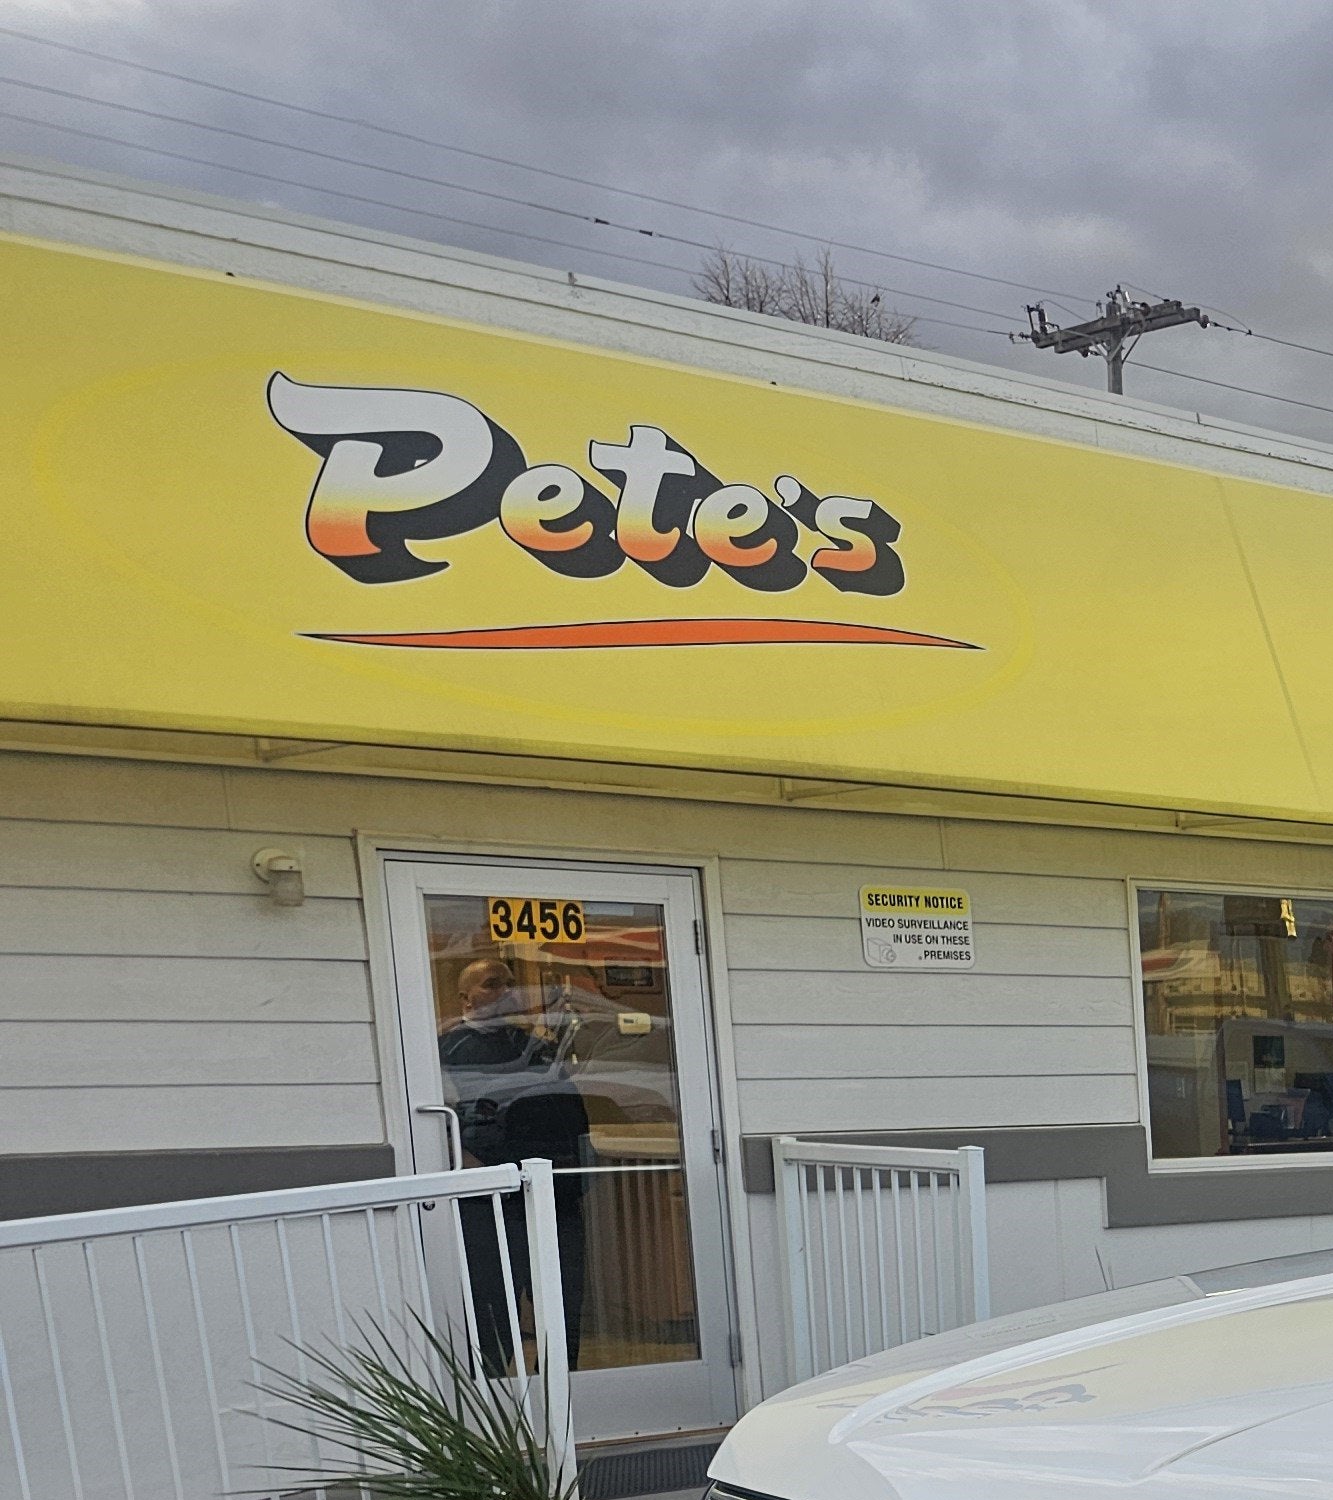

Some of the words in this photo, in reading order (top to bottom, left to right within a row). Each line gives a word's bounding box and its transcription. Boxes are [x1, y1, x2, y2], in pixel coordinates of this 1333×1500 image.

[266, 368, 906, 597] Pete's
[867, 892, 921, 908] SECURITY
[924, 895, 964, 910] NOTICE
[492, 899, 583, 941] 3456
[865, 917, 896, 929] VIDEO
[898, 918, 970, 931] SURVEILLANCE
[893, 933, 902, 944] IN
[904, 934, 923, 945] USE
[925, 934, 939, 945] ON
[941, 935, 971, 946] THESE
[923, 949, 971, 961] PREMISES
